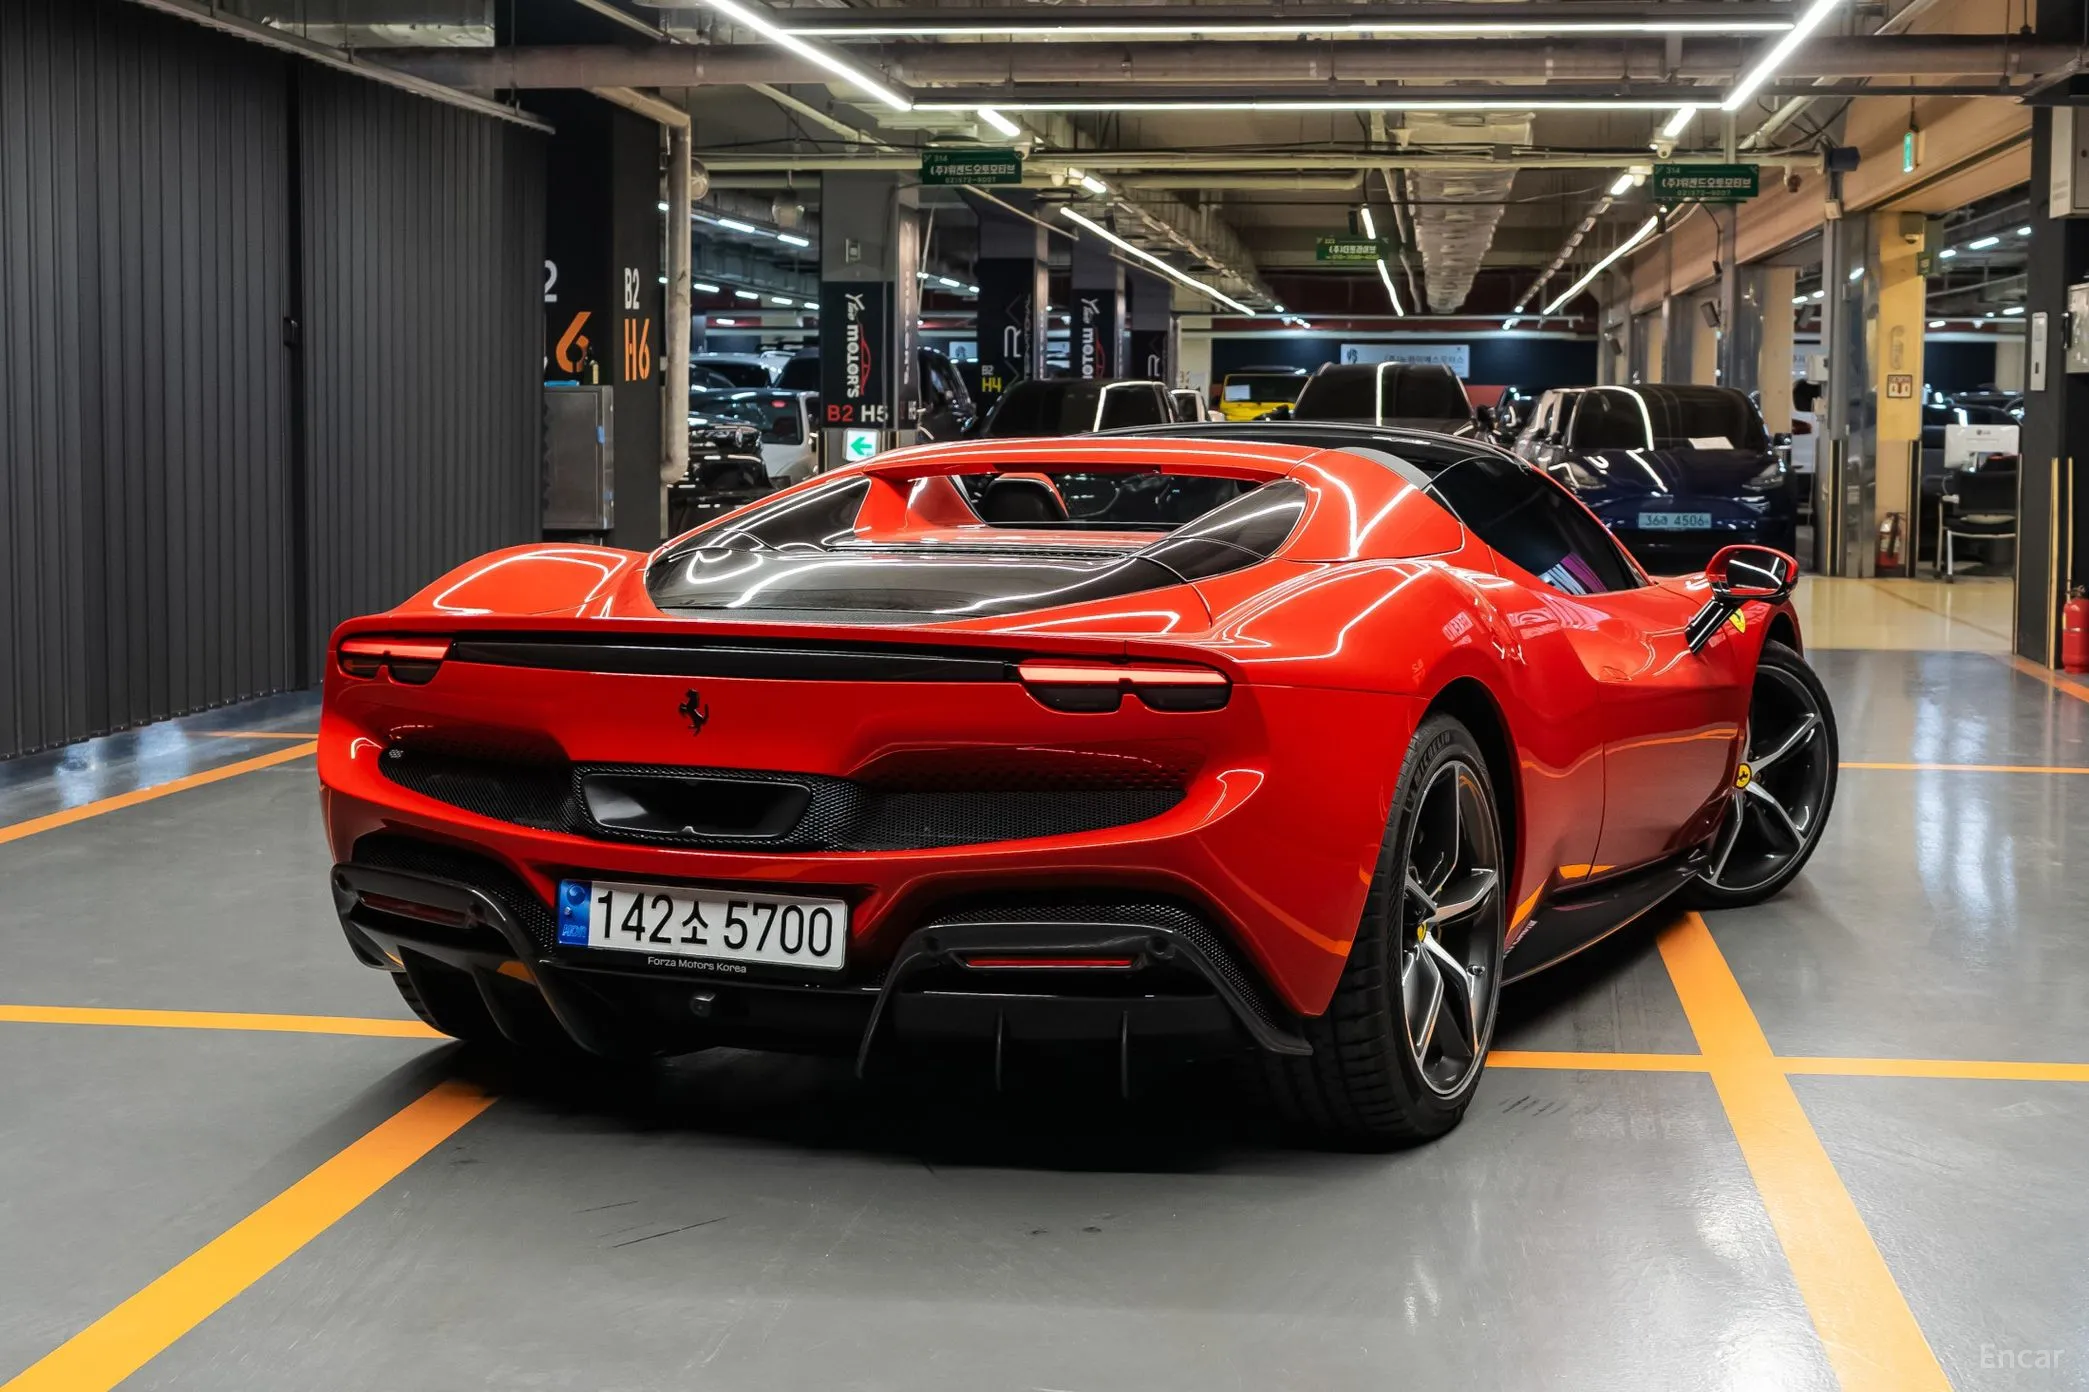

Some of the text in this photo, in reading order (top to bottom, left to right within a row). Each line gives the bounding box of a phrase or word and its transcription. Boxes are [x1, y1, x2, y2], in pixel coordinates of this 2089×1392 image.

[624, 267, 640, 310] B2
[624, 318, 650, 381] H6
[1082, 327, 1094, 380] MOTO
[981, 365, 995, 376] B2
[981, 377, 1002, 392] H4
[827, 404, 854, 422] B2
[860, 404, 888, 423] H5
[1673, 515, 1705, 526] 4506
[597, 889, 833, 957] 142소 5700
[647, 956, 747, 974] Forza Motors Korea
